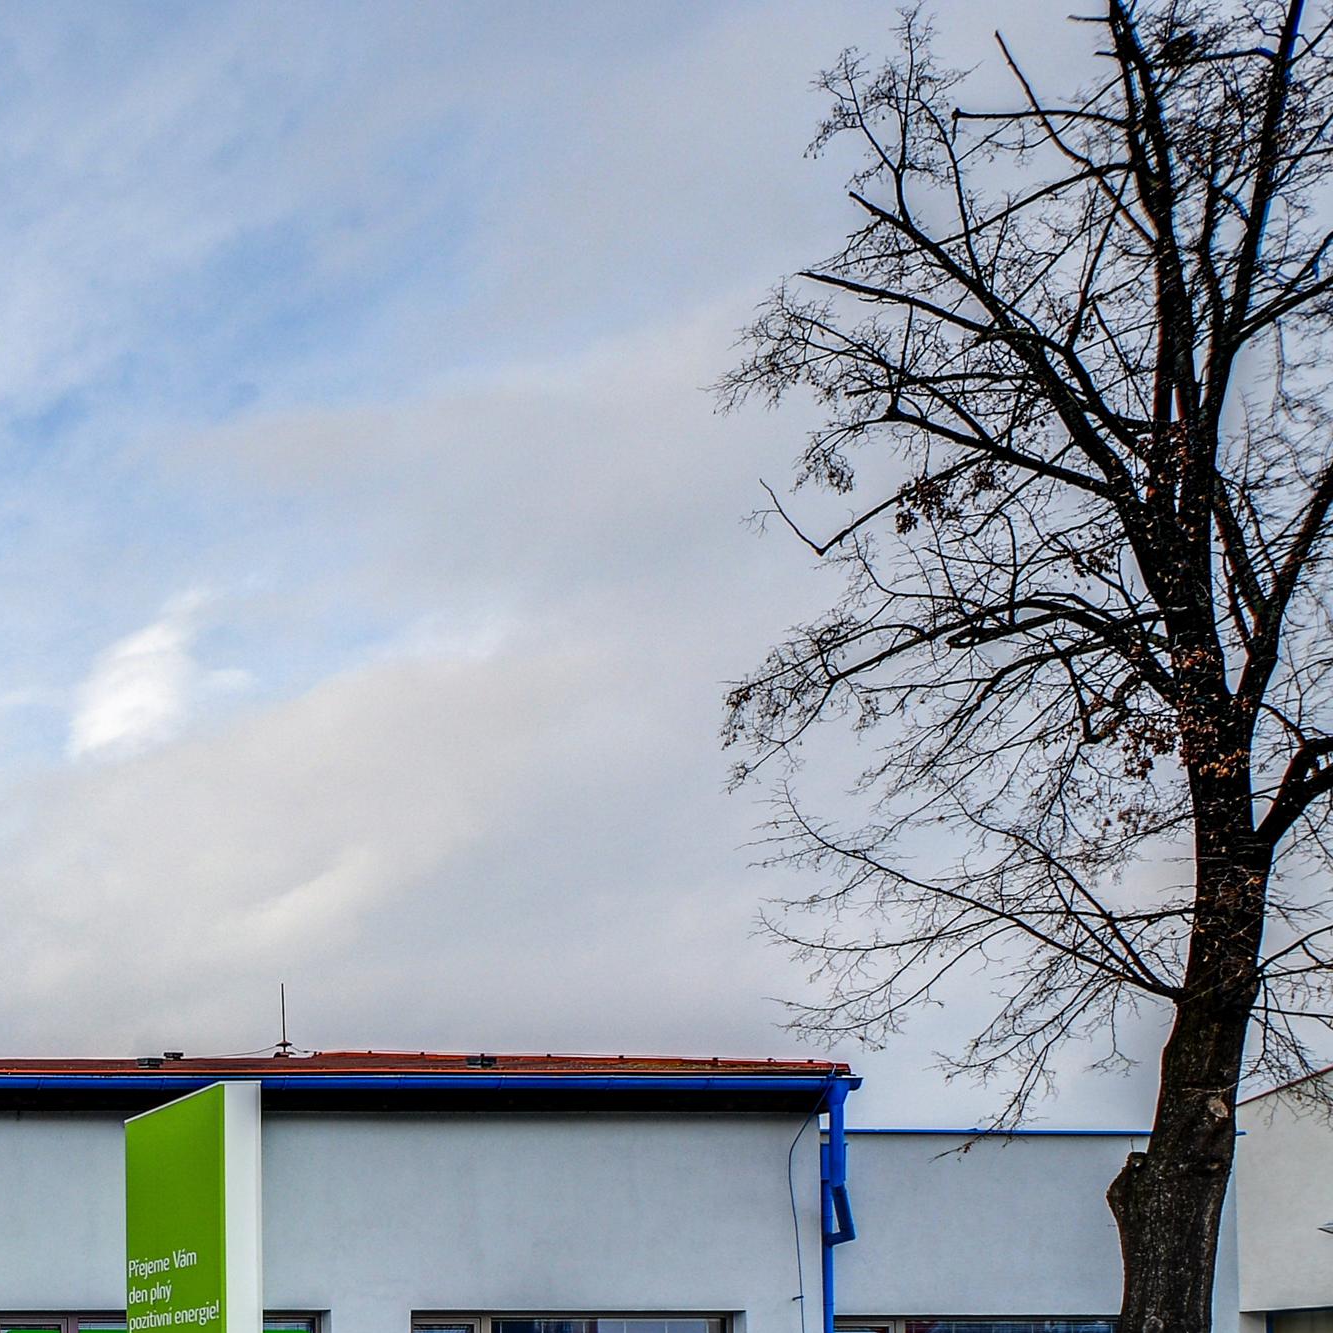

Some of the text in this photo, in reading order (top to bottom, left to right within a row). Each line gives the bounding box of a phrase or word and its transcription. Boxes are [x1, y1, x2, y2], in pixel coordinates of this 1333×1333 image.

[128, 1248, 197, 1280] Přejeme Vám
[128, 1280, 172, 1305] den plný
[174, 1299, 220, 1326] energie!
